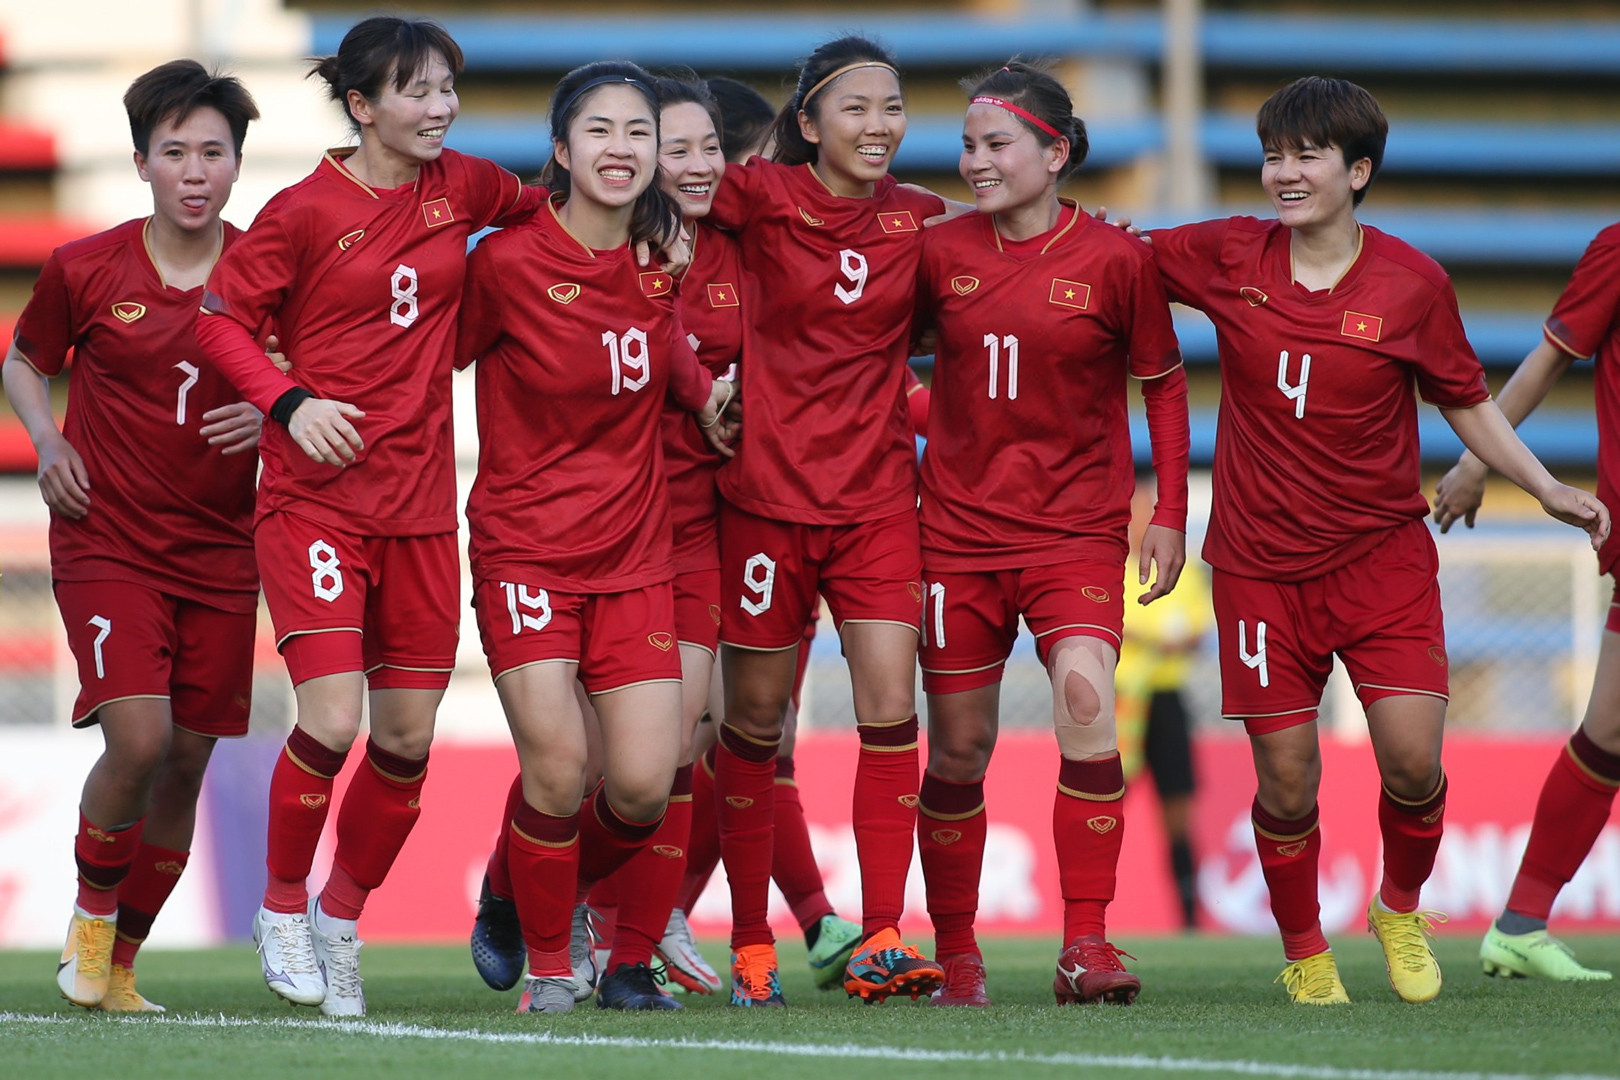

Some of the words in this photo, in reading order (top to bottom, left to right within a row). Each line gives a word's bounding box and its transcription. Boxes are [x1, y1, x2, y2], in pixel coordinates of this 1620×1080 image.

[389, 263, 420, 329] 8
[833, 248, 869, 305] 9
[173, 360, 200, 426] 7
[601, 326, 650, 396] 19
[983, 332, 1020, 401] 11
[1277, 349, 1312, 420] 4
[308, 539, 344, 603] 8
[740, 552, 777, 617] 9
[499, 581, 552, 635] 19
[86, 614, 111, 679] 7
[1238, 619, 1269, 688] 4
